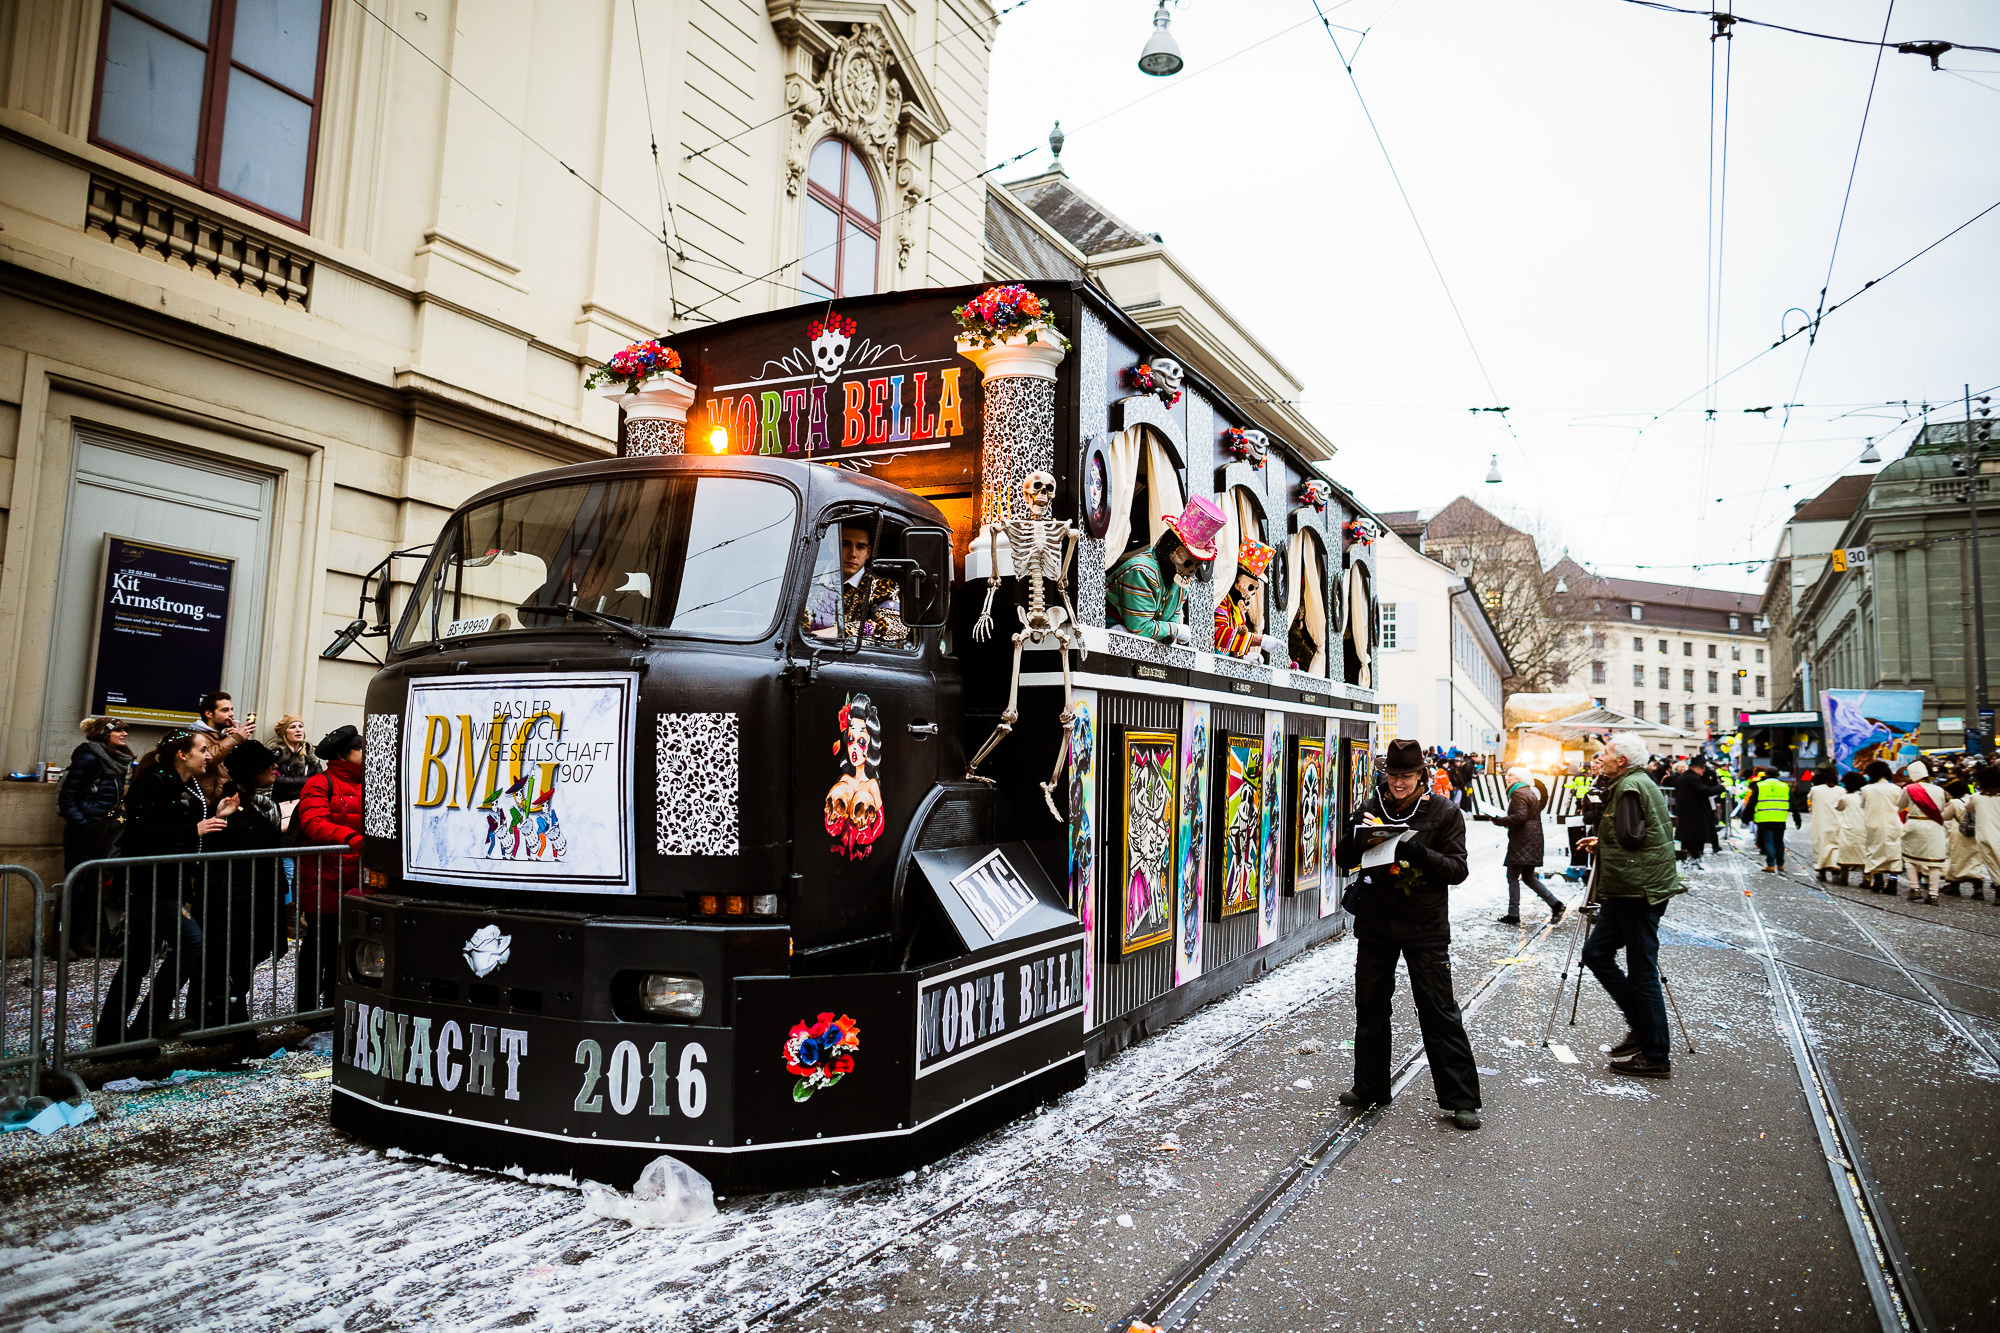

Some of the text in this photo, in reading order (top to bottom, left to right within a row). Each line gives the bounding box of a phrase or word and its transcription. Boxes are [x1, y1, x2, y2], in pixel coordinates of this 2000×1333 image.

[706, 367, 964, 456] MORTA BELLA
[1848, 551, 1866, 563] 30
[112, 573, 141, 592] Kit
[110, 589, 204, 621] Armstrong
[446, 618, 489, 637] BS-99990
[493, 700, 552, 720] BASLER
[471, 721, 569, 742] MITTWOCH-
[413, 711, 564, 812] BMG
[489, 742, 614, 762] GESELLSCHAFT
[555, 764, 594, 784] 1907
[958, 857, 1030, 931] BMG
[920, 948, 1083, 1061] MORTA BELLA
[341, 999, 708, 1118] FASNACHT 2016
